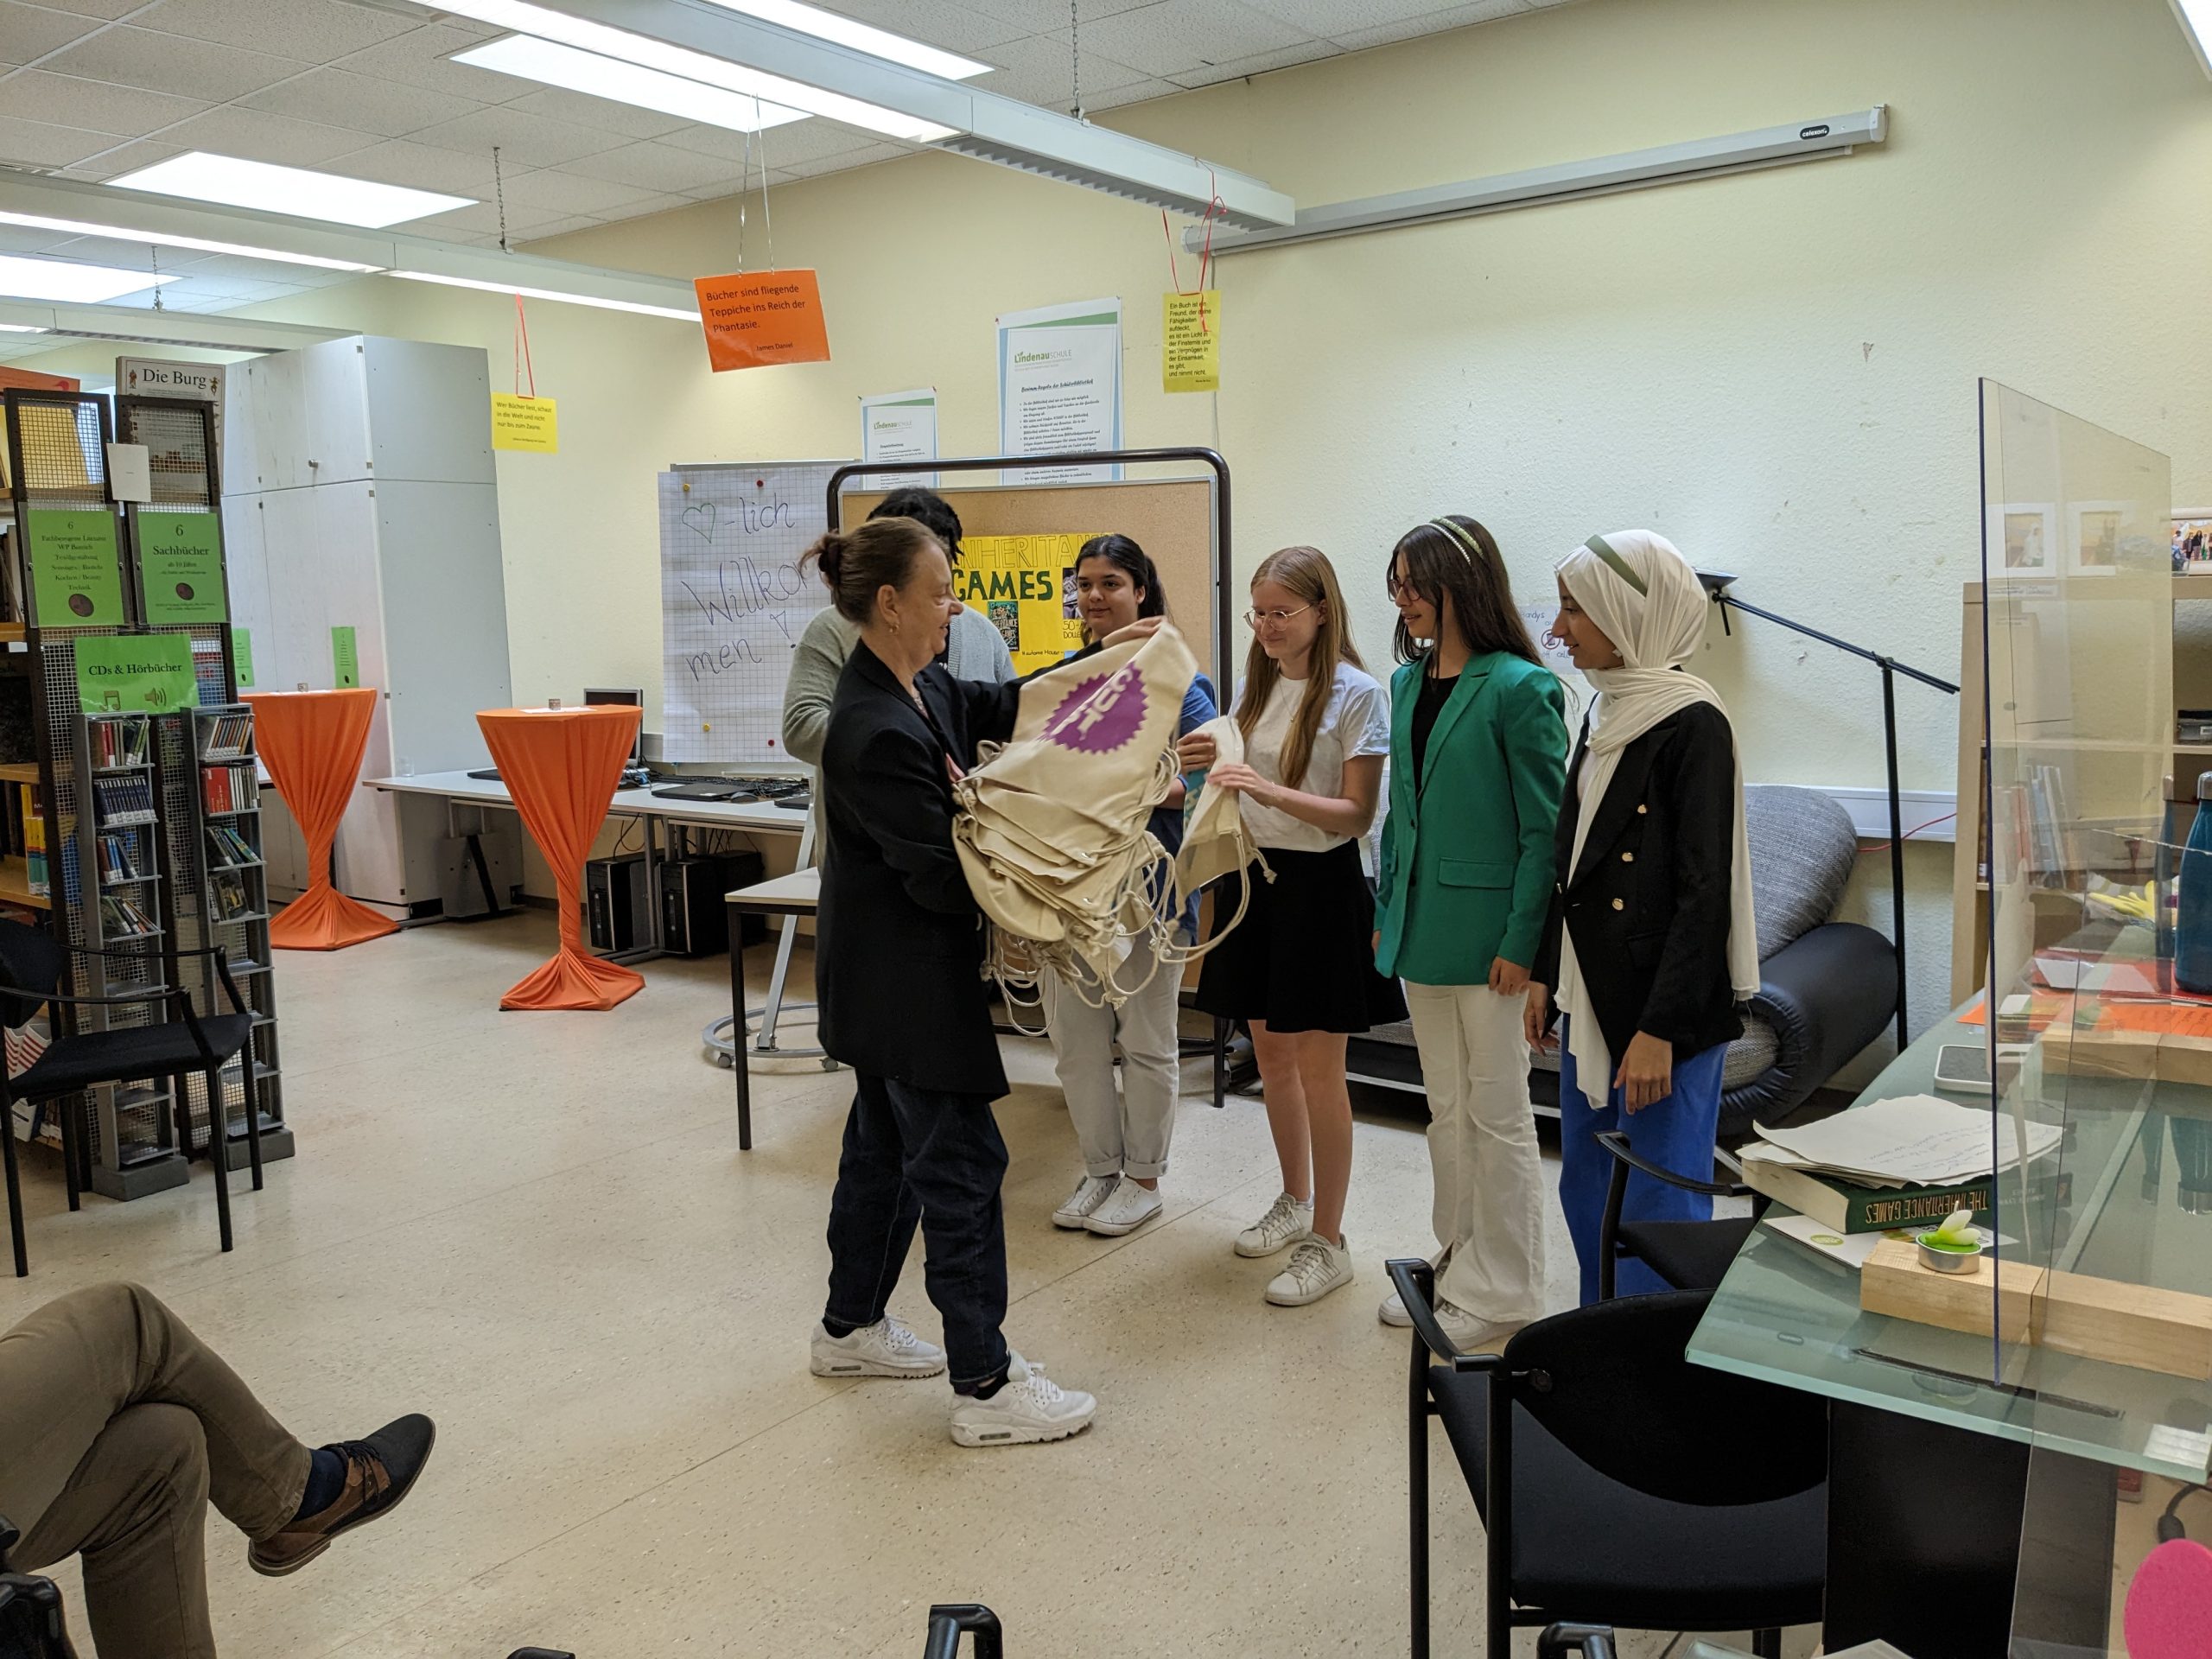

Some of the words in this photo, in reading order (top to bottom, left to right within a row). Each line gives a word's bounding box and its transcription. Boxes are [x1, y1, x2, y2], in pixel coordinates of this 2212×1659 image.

[706, 289, 738, 302] Bücher
[741, 287, 759, 298] sind
[760, 284, 799, 296] fliegende
[709, 305, 751, 319] Teppiche
[753, 303, 766, 313] ins
[767, 302, 791, 310] Reich
[792, 300, 805, 309] der
[713, 321, 760, 333] Phantasie.
[143, 369, 168, 383] Die
[173, 371, 207, 389] Burg
[67, 521, 74, 530] 6
[175, 524, 184, 537] 6
[153, 545, 210, 556] Sachbücher
[951, 569, 1053, 602] GAMES
[89, 665, 112, 676] CDs
[115, 664, 124, 675] &
[126, 662, 182, 674] Hörbücher
[686, 638, 762, 682] men
[1904, 1192, 1967, 1220] INHERITANCE
[1969, 1190, 1988, 1211] THE
[1866, 1199, 1902, 1224] GAMES
